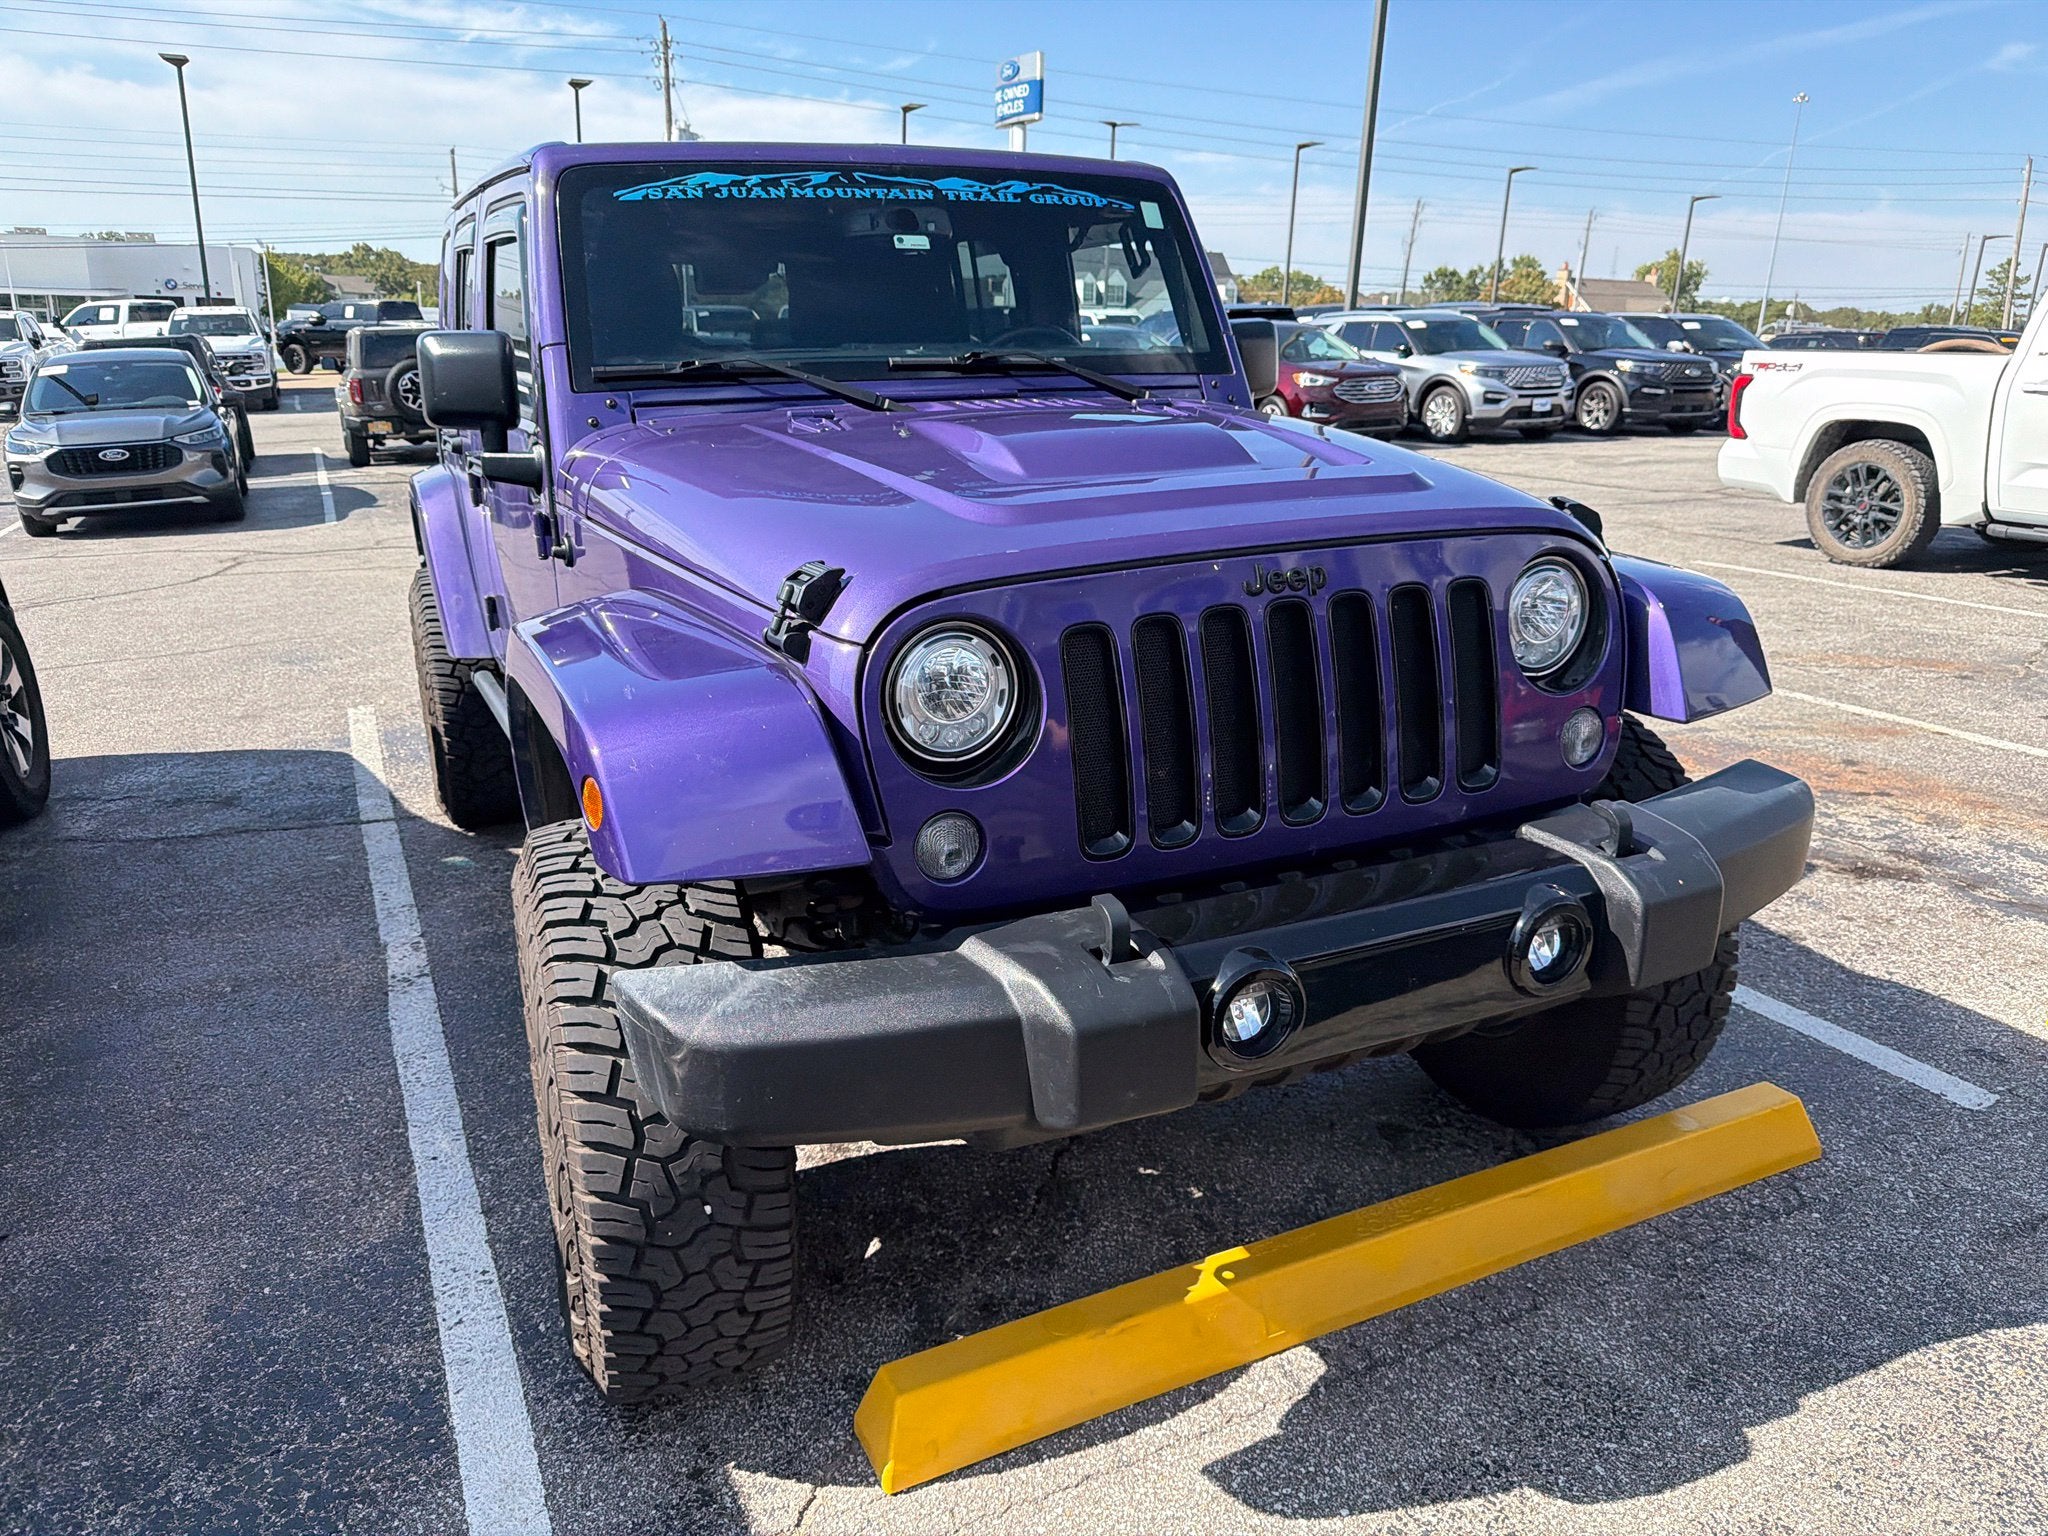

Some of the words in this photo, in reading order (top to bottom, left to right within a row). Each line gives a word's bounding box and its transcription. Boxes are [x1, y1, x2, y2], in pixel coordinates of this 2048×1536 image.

[647, 186, 703, 199] SAN
[713, 186, 785, 199] JUAN
[789, 187, 934, 200] MOUNTAIN
[942, 190, 1021, 203] TRAIL
[1029, 193, 1108, 208] GROUP
[1242, 563, 1327, 598] Jeep
